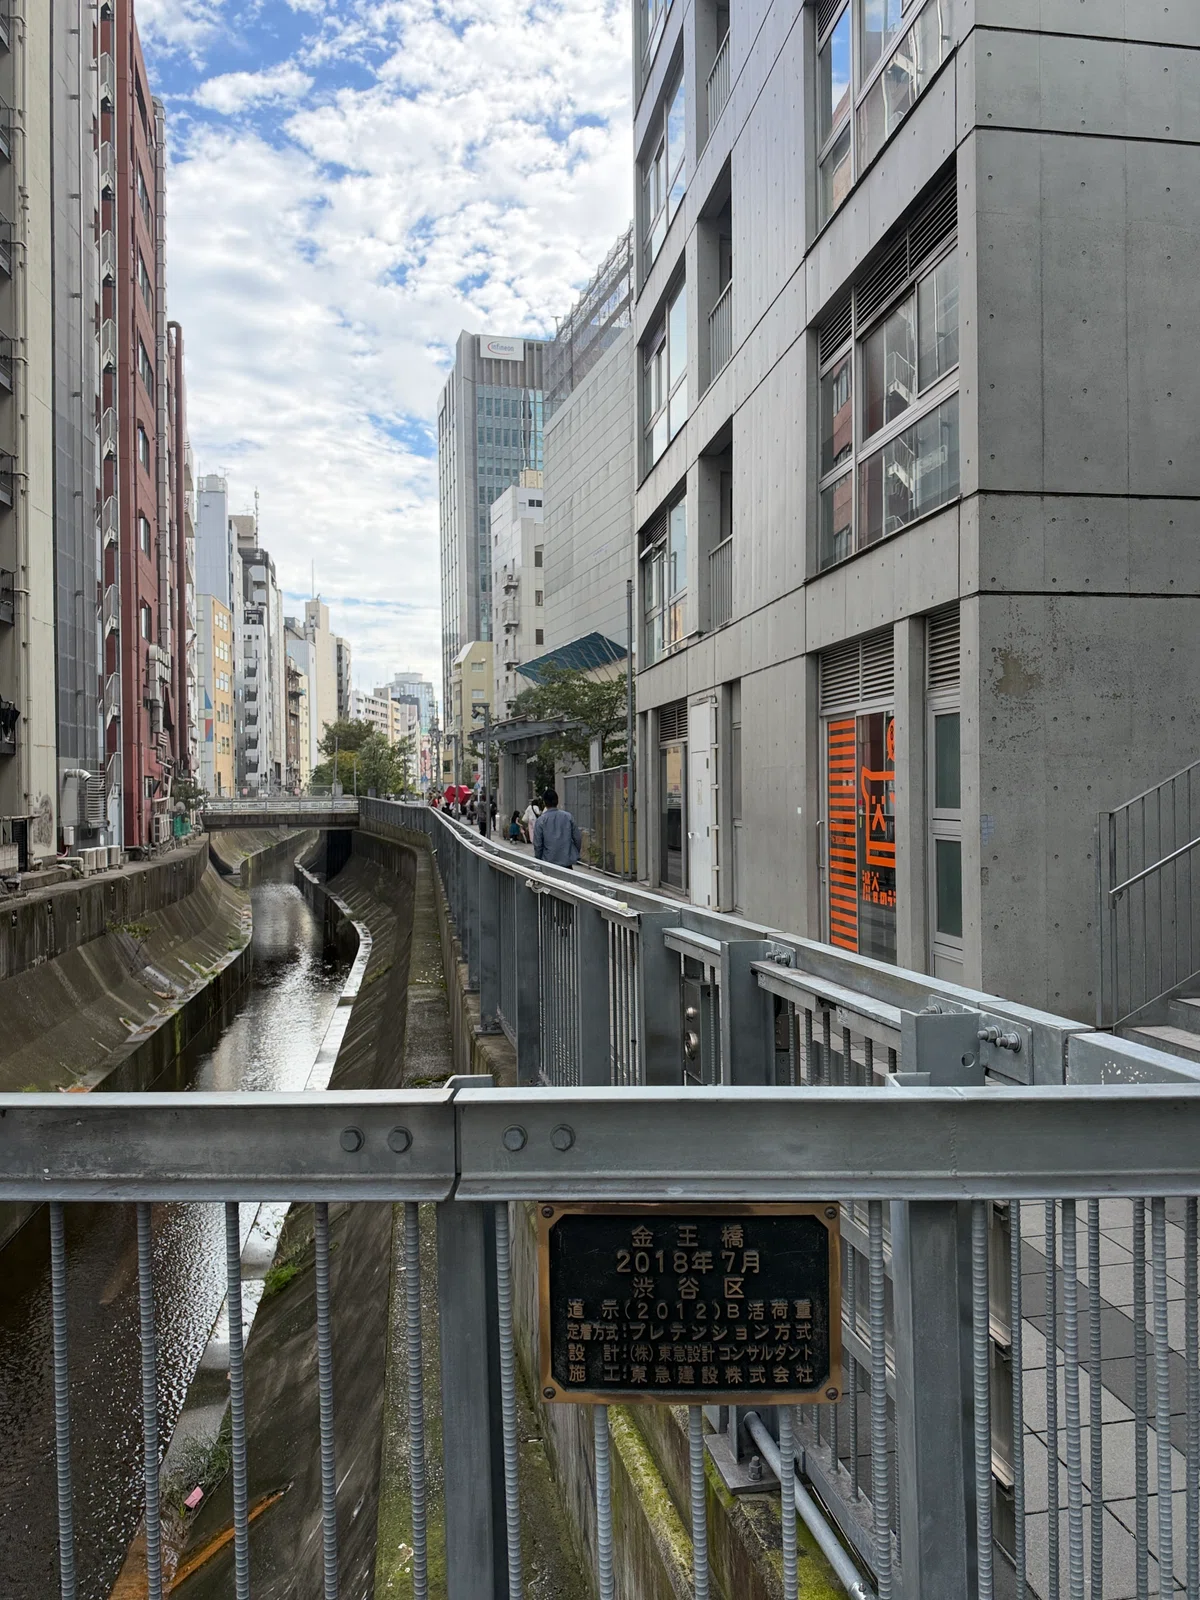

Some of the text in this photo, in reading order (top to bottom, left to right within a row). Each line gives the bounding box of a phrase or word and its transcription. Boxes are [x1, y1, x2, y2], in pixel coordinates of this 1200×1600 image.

[632, 1225, 744, 1248] 金王橋
[616, 1251, 760, 1274] 2018年7月
[633, 1277, 745, 1299] 渋谷区
